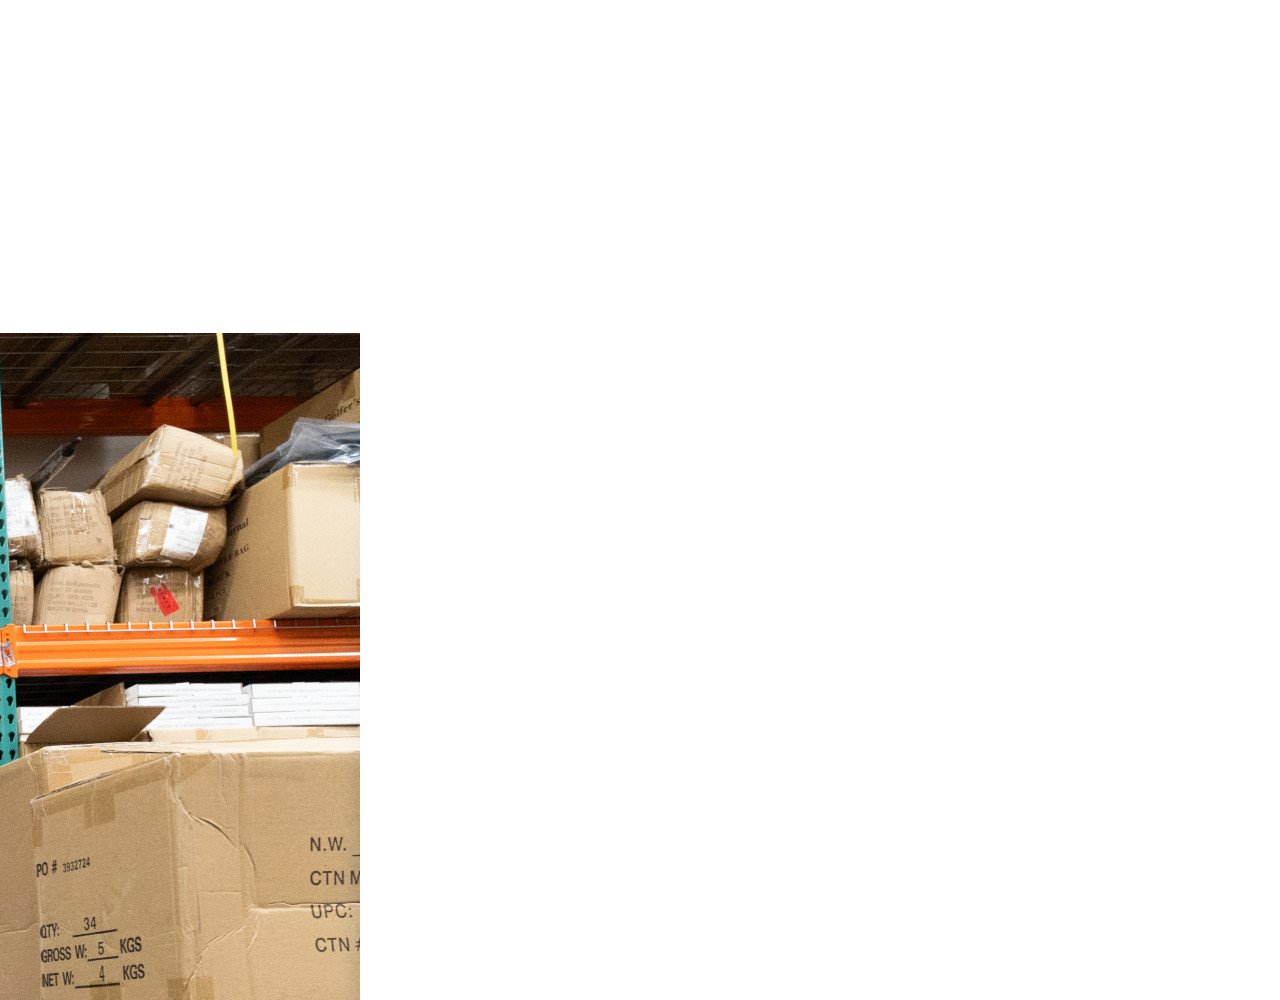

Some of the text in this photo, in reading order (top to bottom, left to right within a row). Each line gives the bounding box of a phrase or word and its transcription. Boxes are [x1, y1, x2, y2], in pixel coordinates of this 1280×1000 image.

[310, 836, 347, 852] N.W.
[36, 857, 91, 878] PO # 3932724
[310, 870, 345, 886] CTN
[310, 904, 353, 919] UPC:
[40, 916, 97, 938] QTY: 34
[40, 936, 143, 963] GROSS W: 5 KGS
[315, 937, 350, 953] CTN
[41, 963, 145, 988] NET W: 4 KGS
